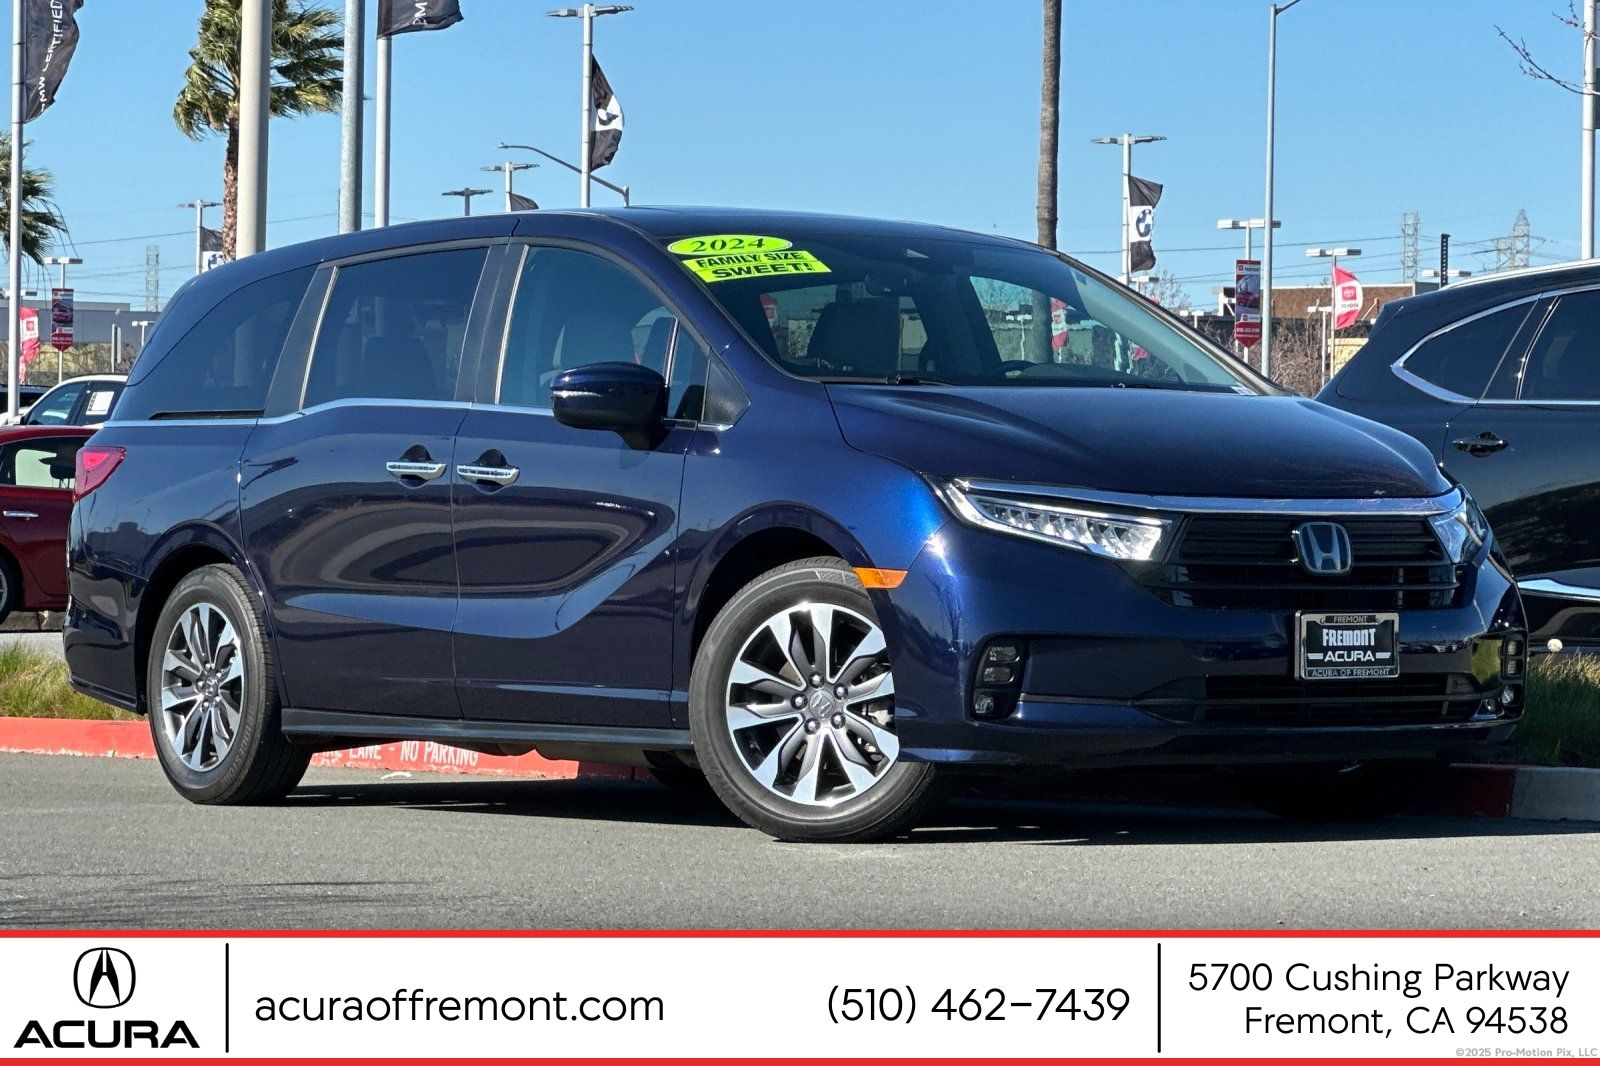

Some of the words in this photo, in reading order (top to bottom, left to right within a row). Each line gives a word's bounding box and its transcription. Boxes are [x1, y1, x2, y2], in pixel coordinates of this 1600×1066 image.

[412, 0, 428, 25] BM
[690, 237, 766, 253] 2024
[695, 254, 761, 268] FAMILY
[711, 262, 815, 278] SWEET!
[1333, 615, 1369, 623] FREMONT
[1322, 627, 1376, 647] FREMONT
[1323, 650, 1375, 662] ACURA
[1311, 669, 1338, 678] ACURA
[1340, 669, 1352, 677] OF
[1353, 668, 1391, 677] FREMONT
[400, 741, 420, 762] NO
[423, 741, 479, 767] PARKING
